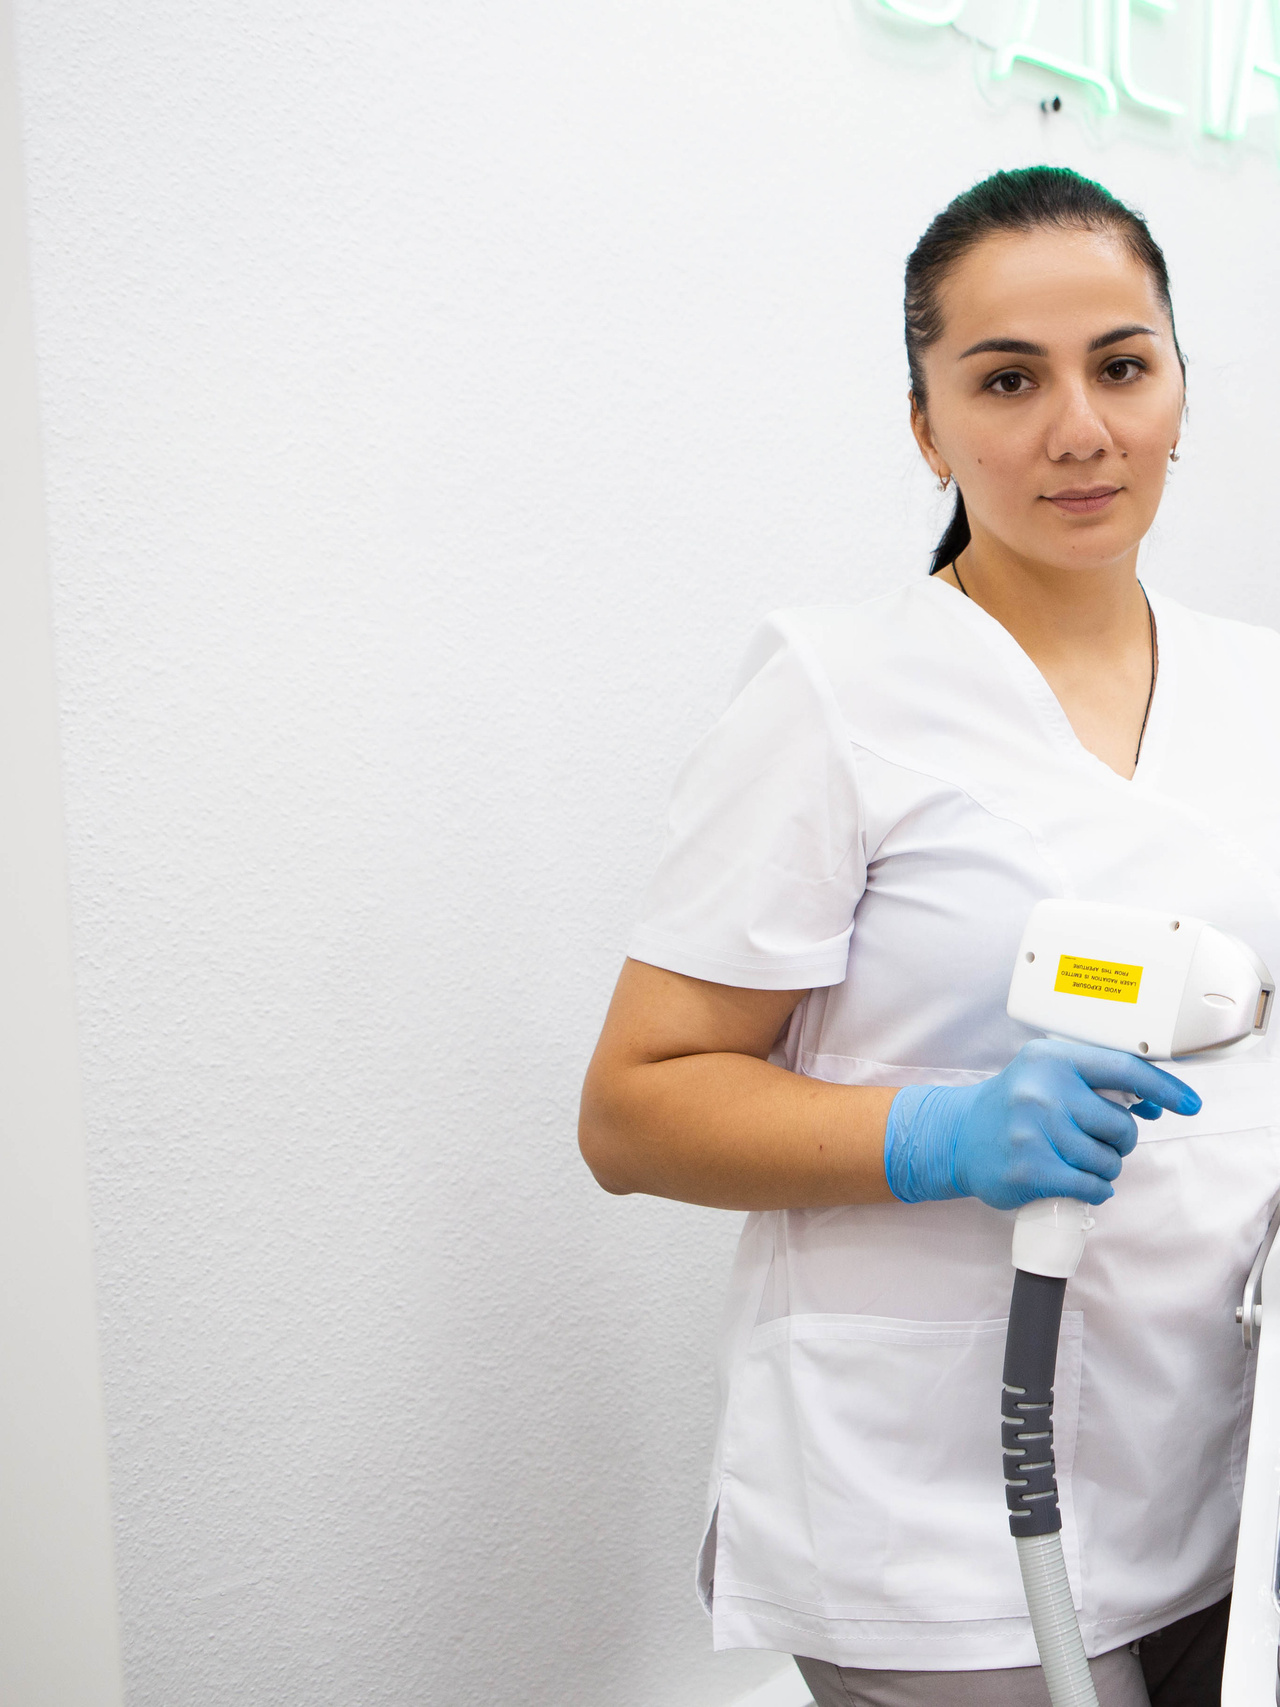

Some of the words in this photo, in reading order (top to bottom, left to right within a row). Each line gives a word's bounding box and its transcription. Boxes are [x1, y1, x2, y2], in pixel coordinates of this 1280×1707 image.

[1073, 963, 1100, 972] APERTURE
[1091, 975, 1118, 984] RADIATION
[1072, 981, 1102, 991] EXPOSURE
[1104, 986, 1122, 994] AVOID
